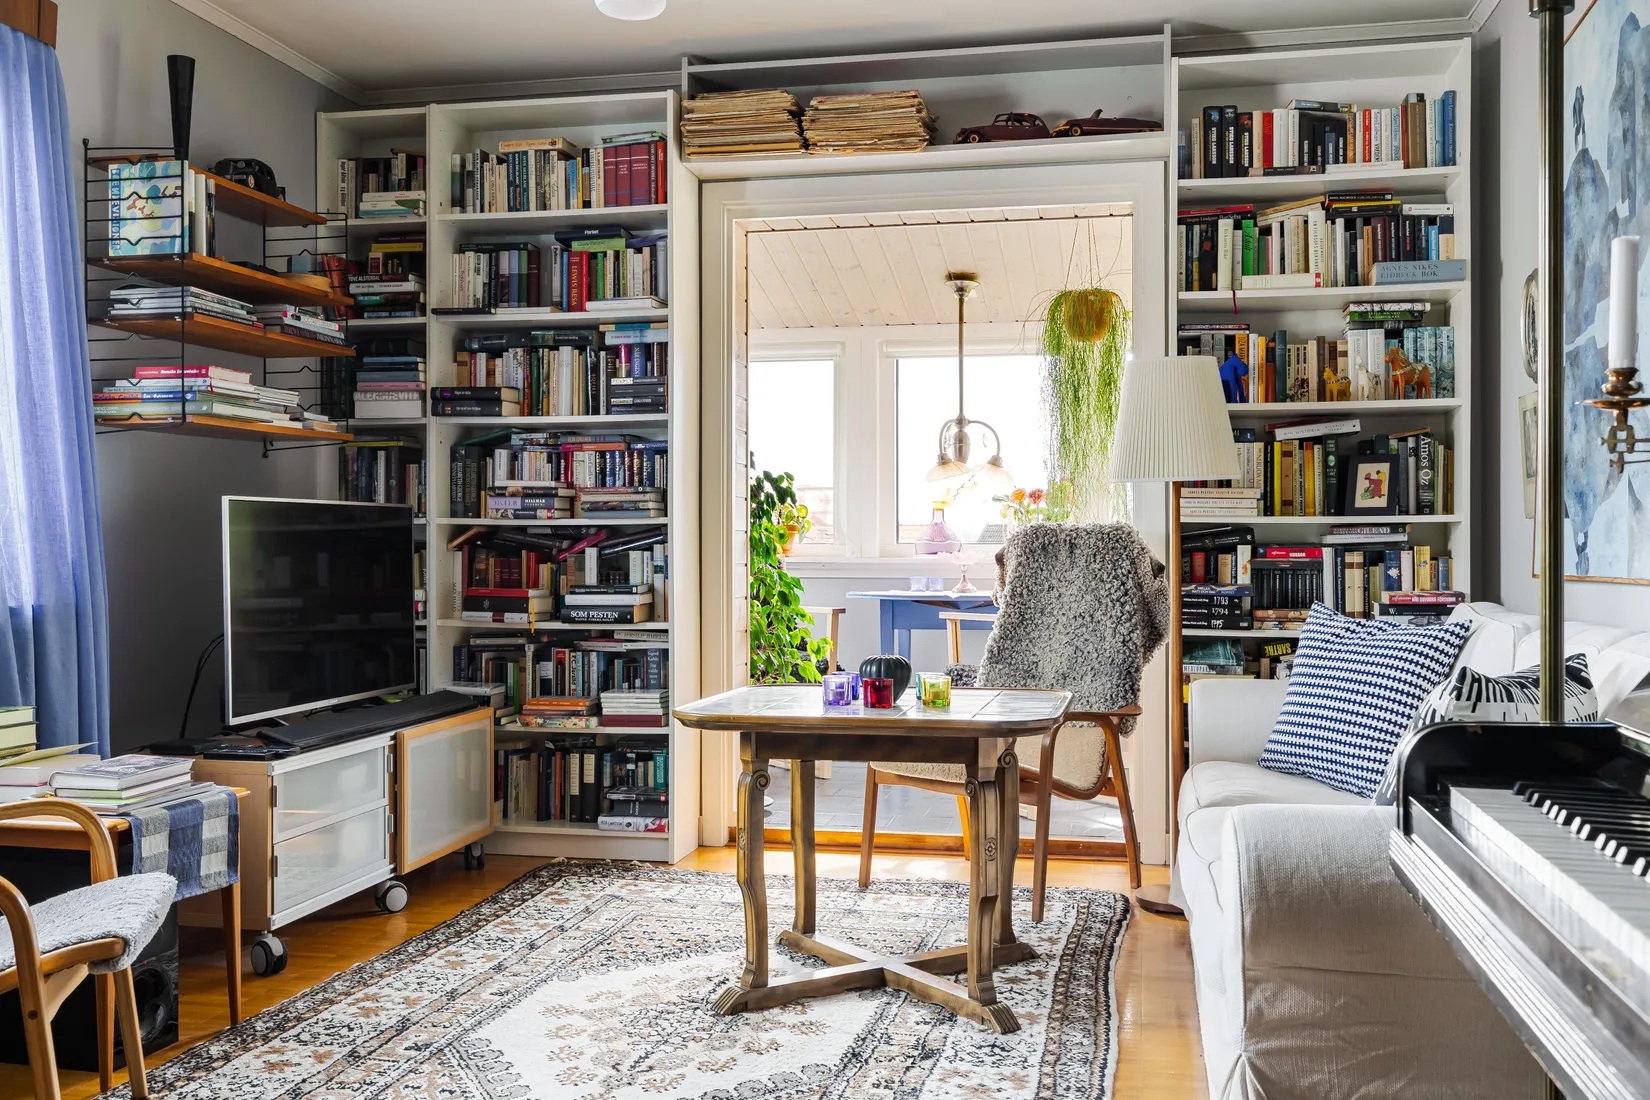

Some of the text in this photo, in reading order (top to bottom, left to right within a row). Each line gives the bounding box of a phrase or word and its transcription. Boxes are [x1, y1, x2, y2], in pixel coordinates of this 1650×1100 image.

[1412, 263, 1439, 271] NIKES
[1420, 436, 1432, 486] Amos Oz
[1213, 596, 1228, 605] 1793
[589, 611, 618, 620] PESTEN
[1212, 608, 1228, 616] 1794
[1264, 642, 1292, 657] SARTRE
